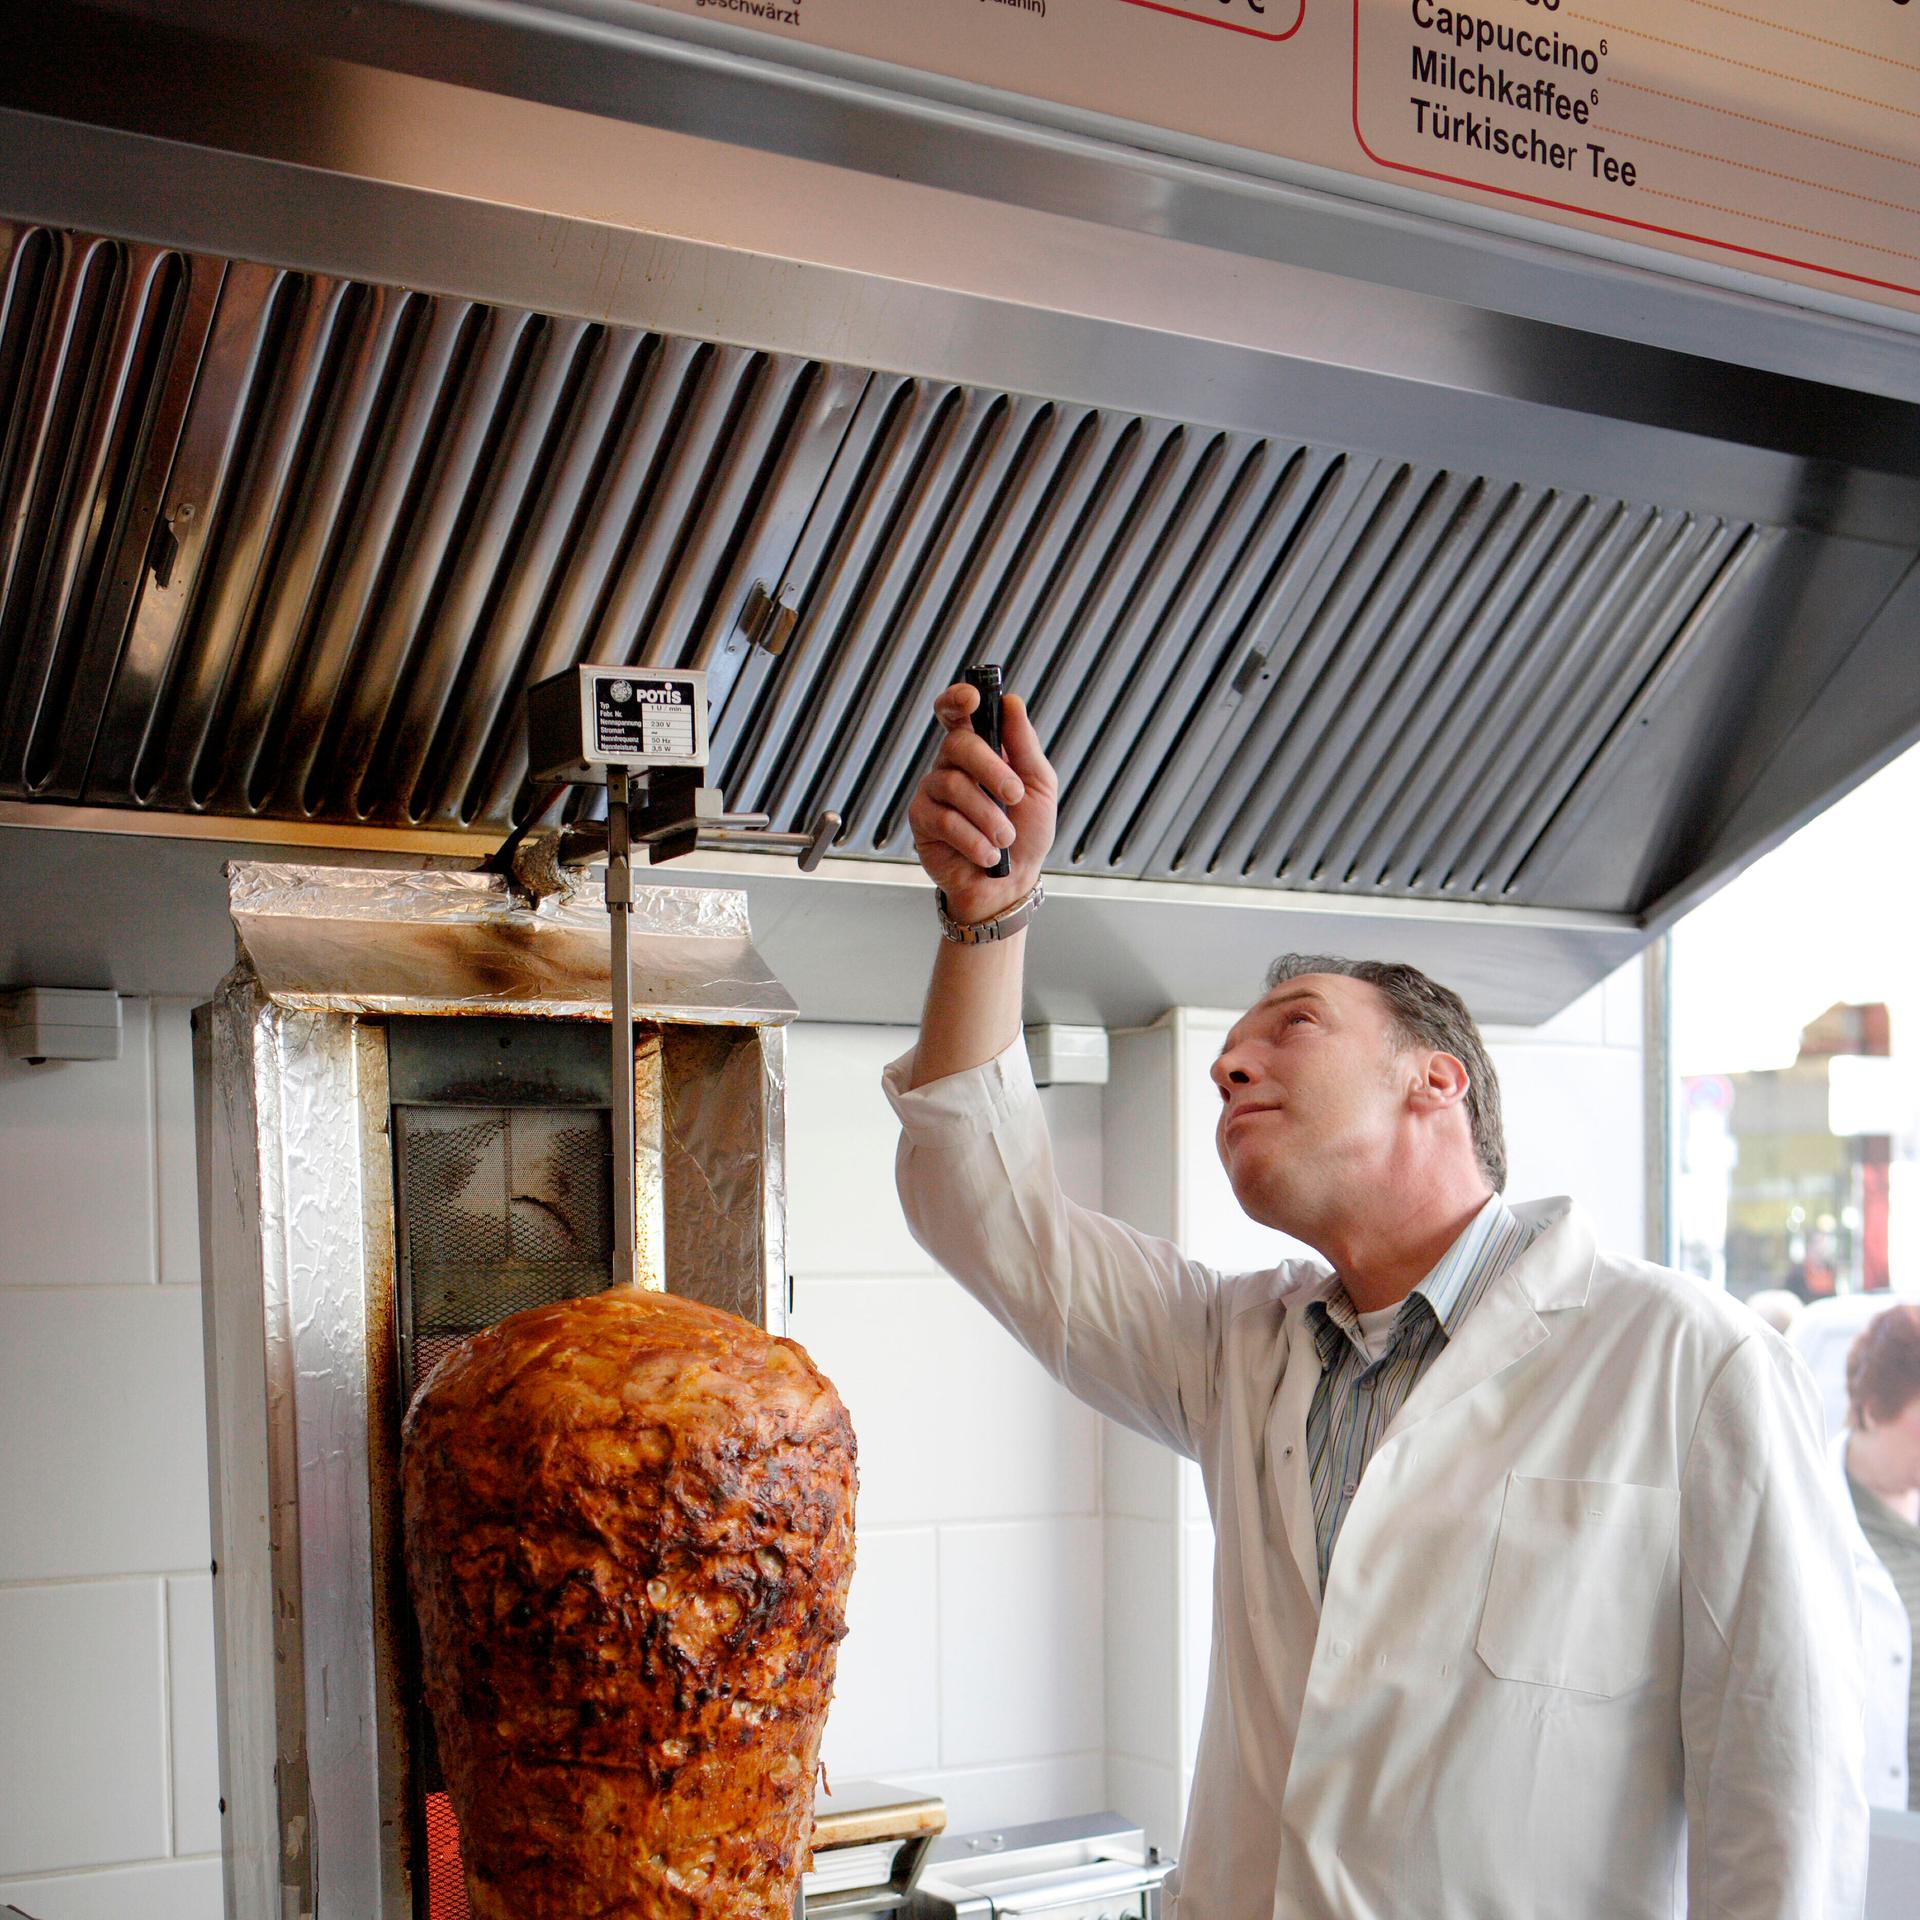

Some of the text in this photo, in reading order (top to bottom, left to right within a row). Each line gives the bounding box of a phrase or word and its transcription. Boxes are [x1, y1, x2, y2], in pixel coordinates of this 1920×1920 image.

[1410, 97, 1637, 187] Türkischer Tee
[600, 702, 610, 710] Typ
